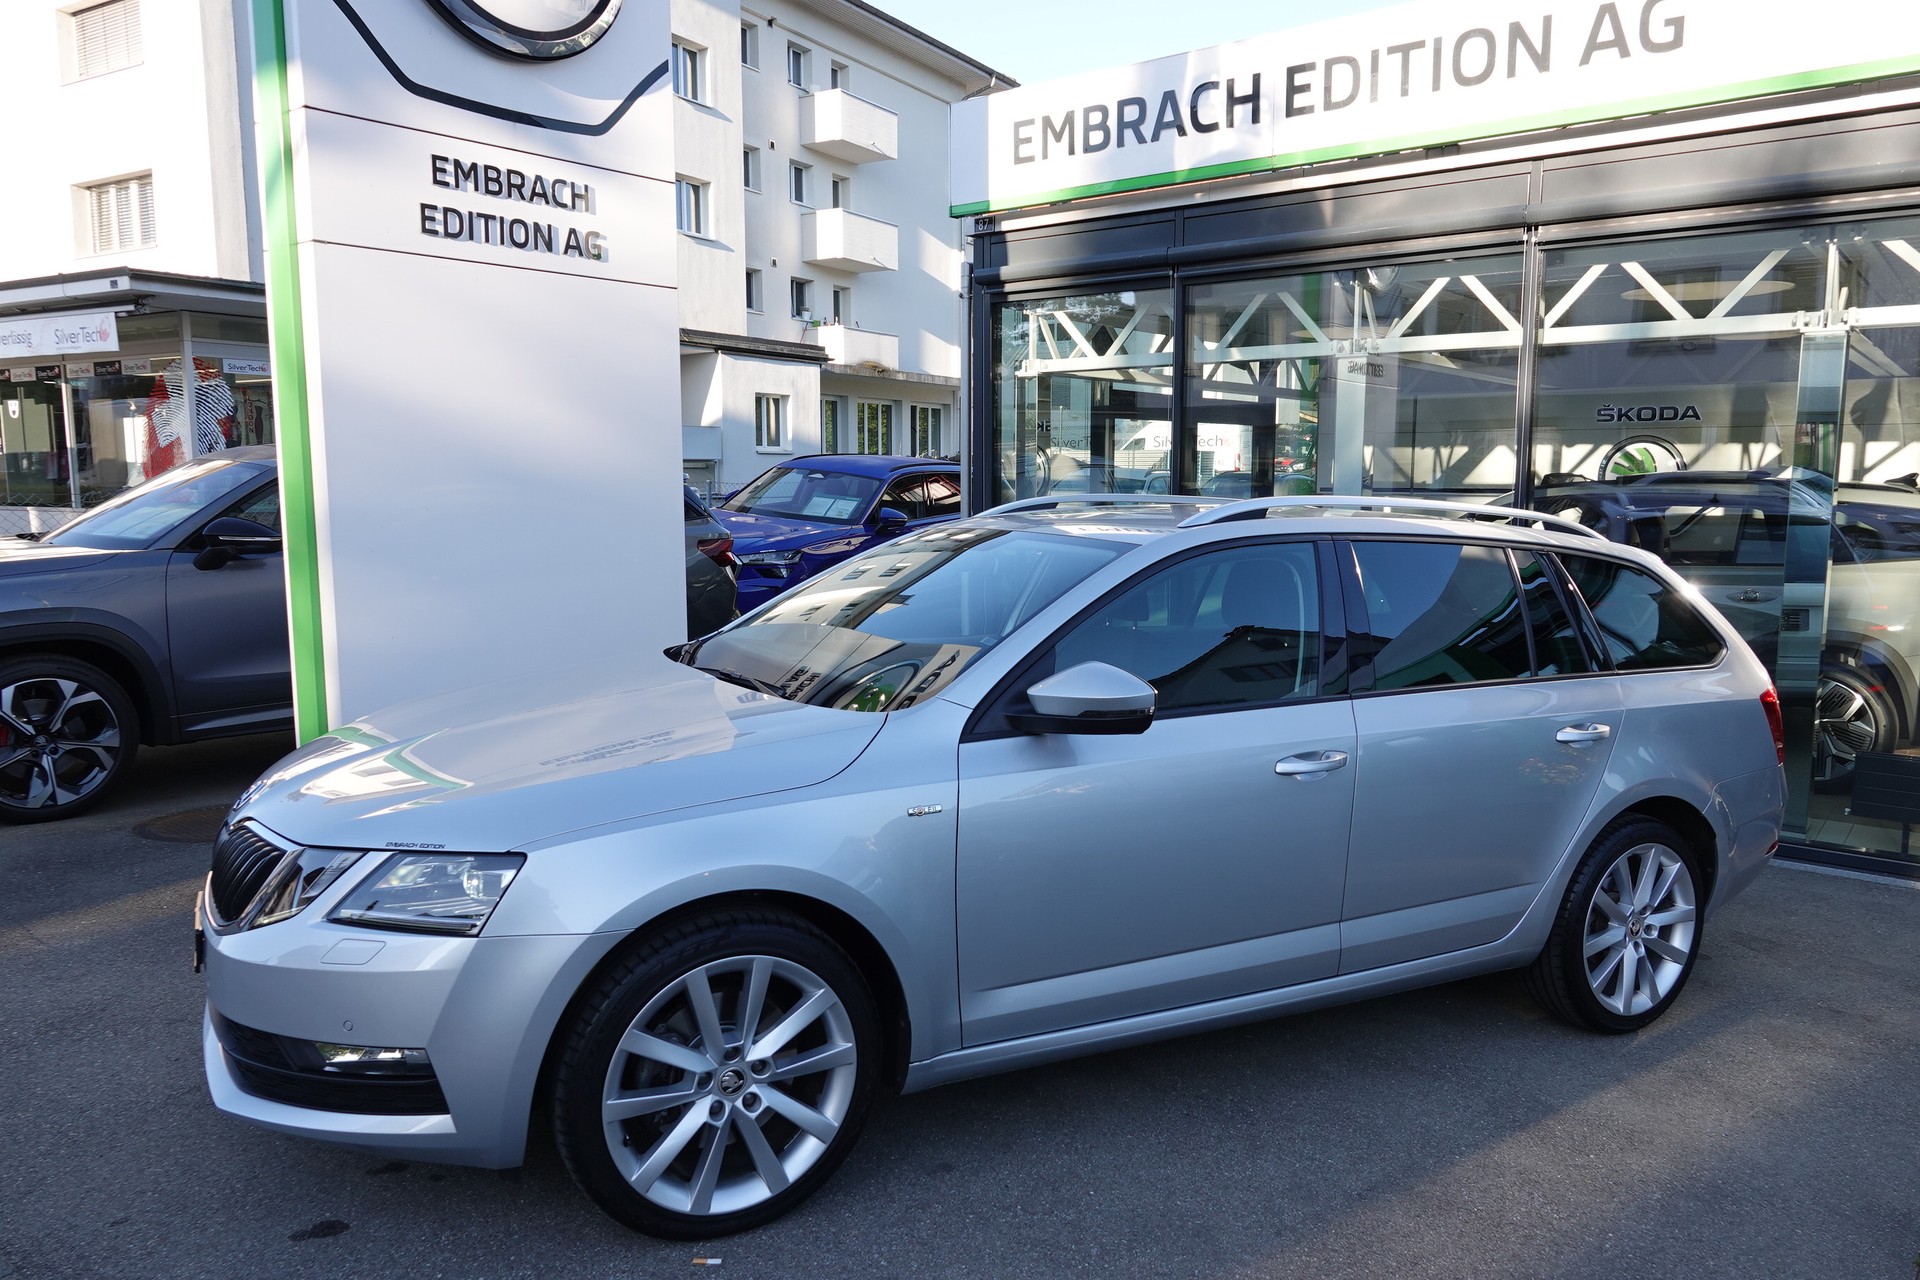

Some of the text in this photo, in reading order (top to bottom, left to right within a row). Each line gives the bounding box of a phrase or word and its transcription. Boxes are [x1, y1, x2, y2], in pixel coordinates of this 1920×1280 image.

[1013, 0, 1685, 165] EMBRACH EDITION AG
[431, 153, 590, 213] EMBRACH
[420, 202, 603, 261] EDITION AG
[978, 218, 989, 231] 87
[54, 325, 101, 345] SilverTech
[227, 362, 263, 372] SilverTech
[1597, 404, 1702, 422] ŠKODA
